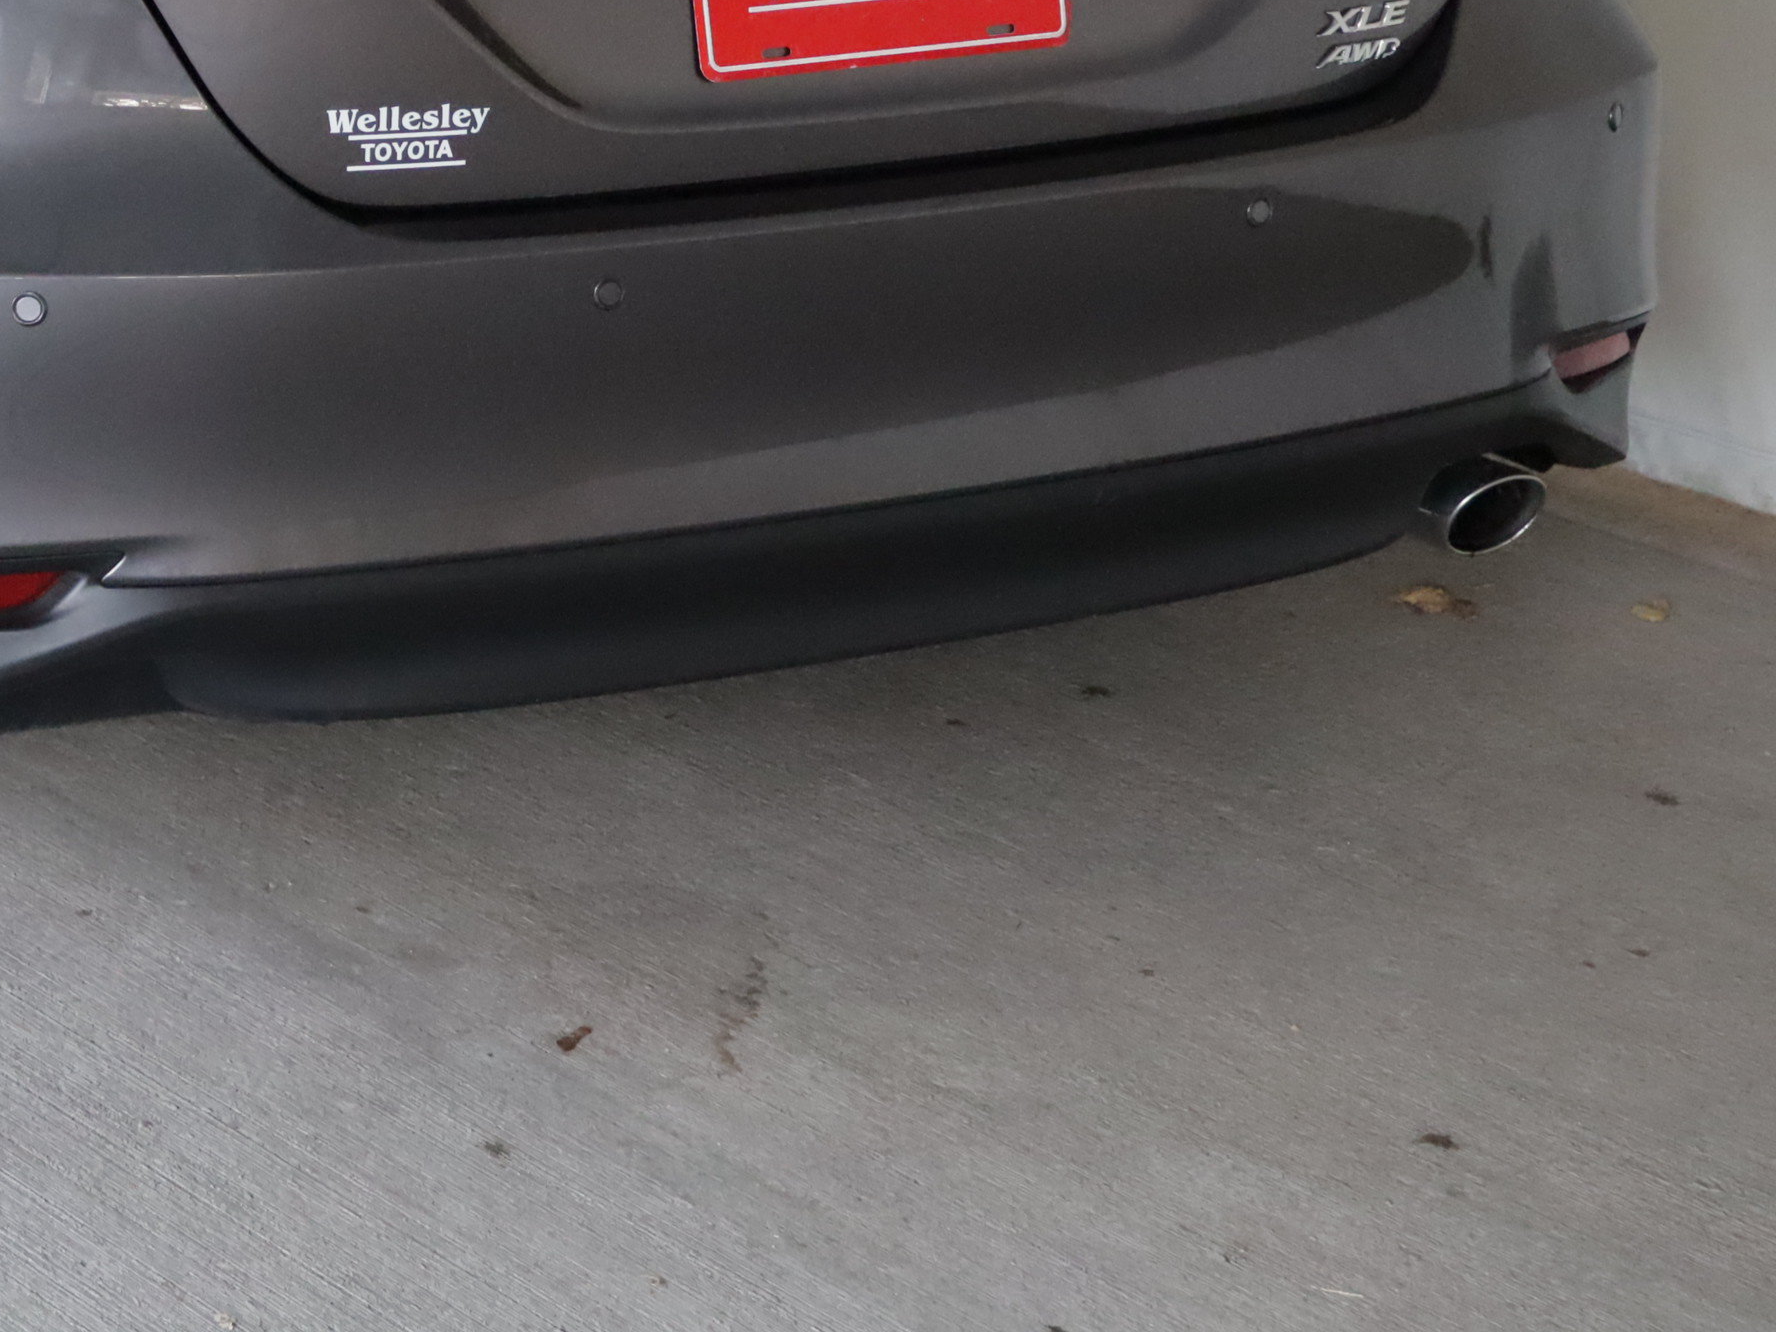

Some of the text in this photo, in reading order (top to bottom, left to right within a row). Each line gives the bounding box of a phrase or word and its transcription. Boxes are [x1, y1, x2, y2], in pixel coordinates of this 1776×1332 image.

[1316, 0, 1410, 37] XLE
[1315, 37, 1401, 68] AWD
[326, 103, 491, 134] Wellesley
[361, 139, 454, 163] TOYOTA
